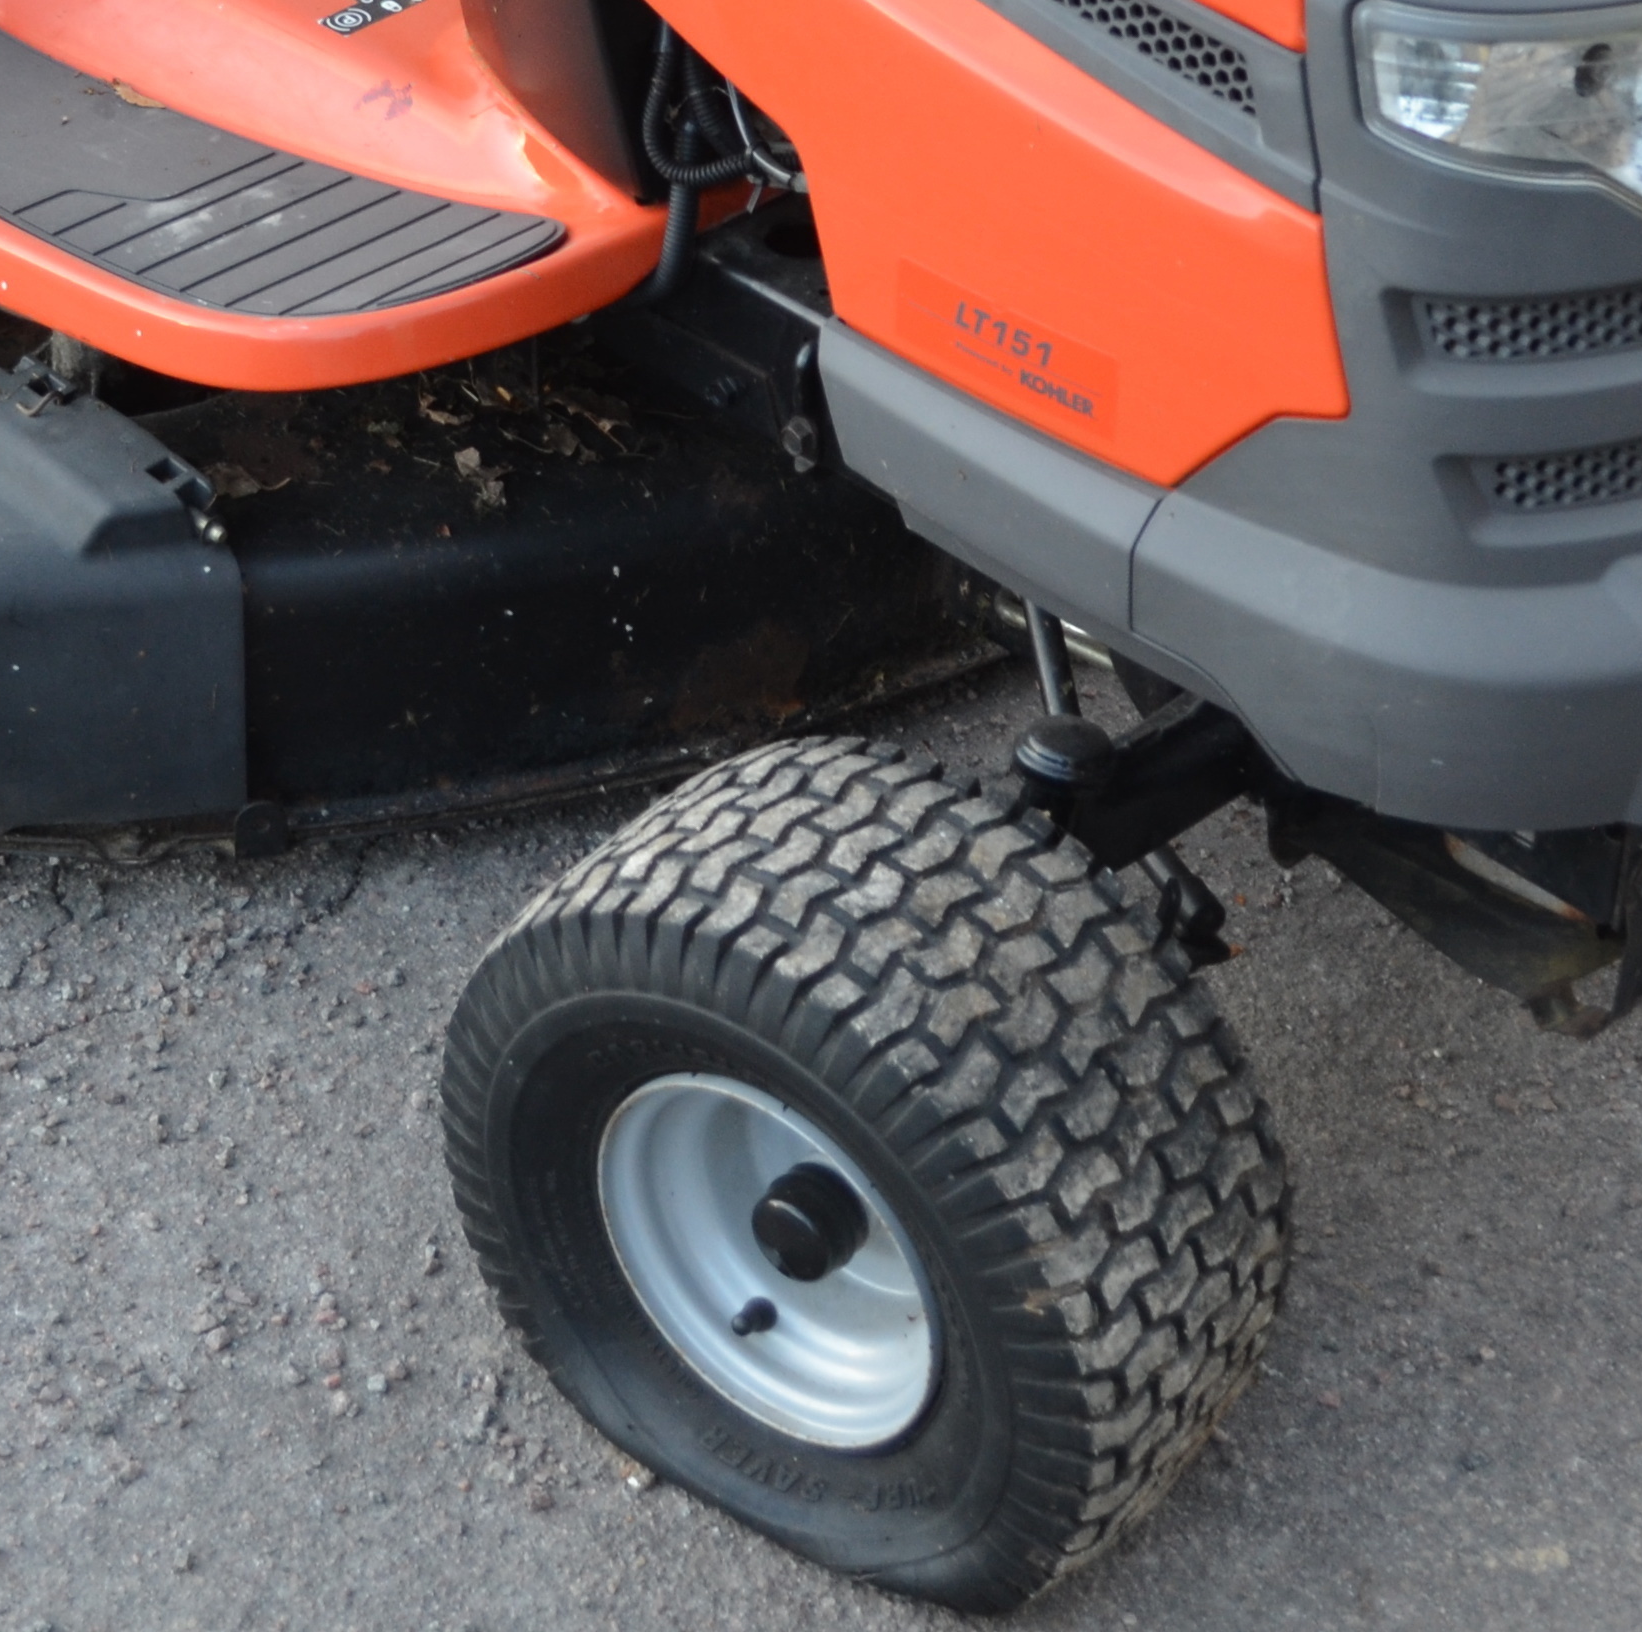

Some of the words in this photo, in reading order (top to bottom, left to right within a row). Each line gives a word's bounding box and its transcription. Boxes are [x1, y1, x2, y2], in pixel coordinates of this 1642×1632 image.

[955, 301, 1053, 367] LT151
[1019, 369, 1096, 418] KOHLER
[699, 1425, 826, 1506] SAVER
